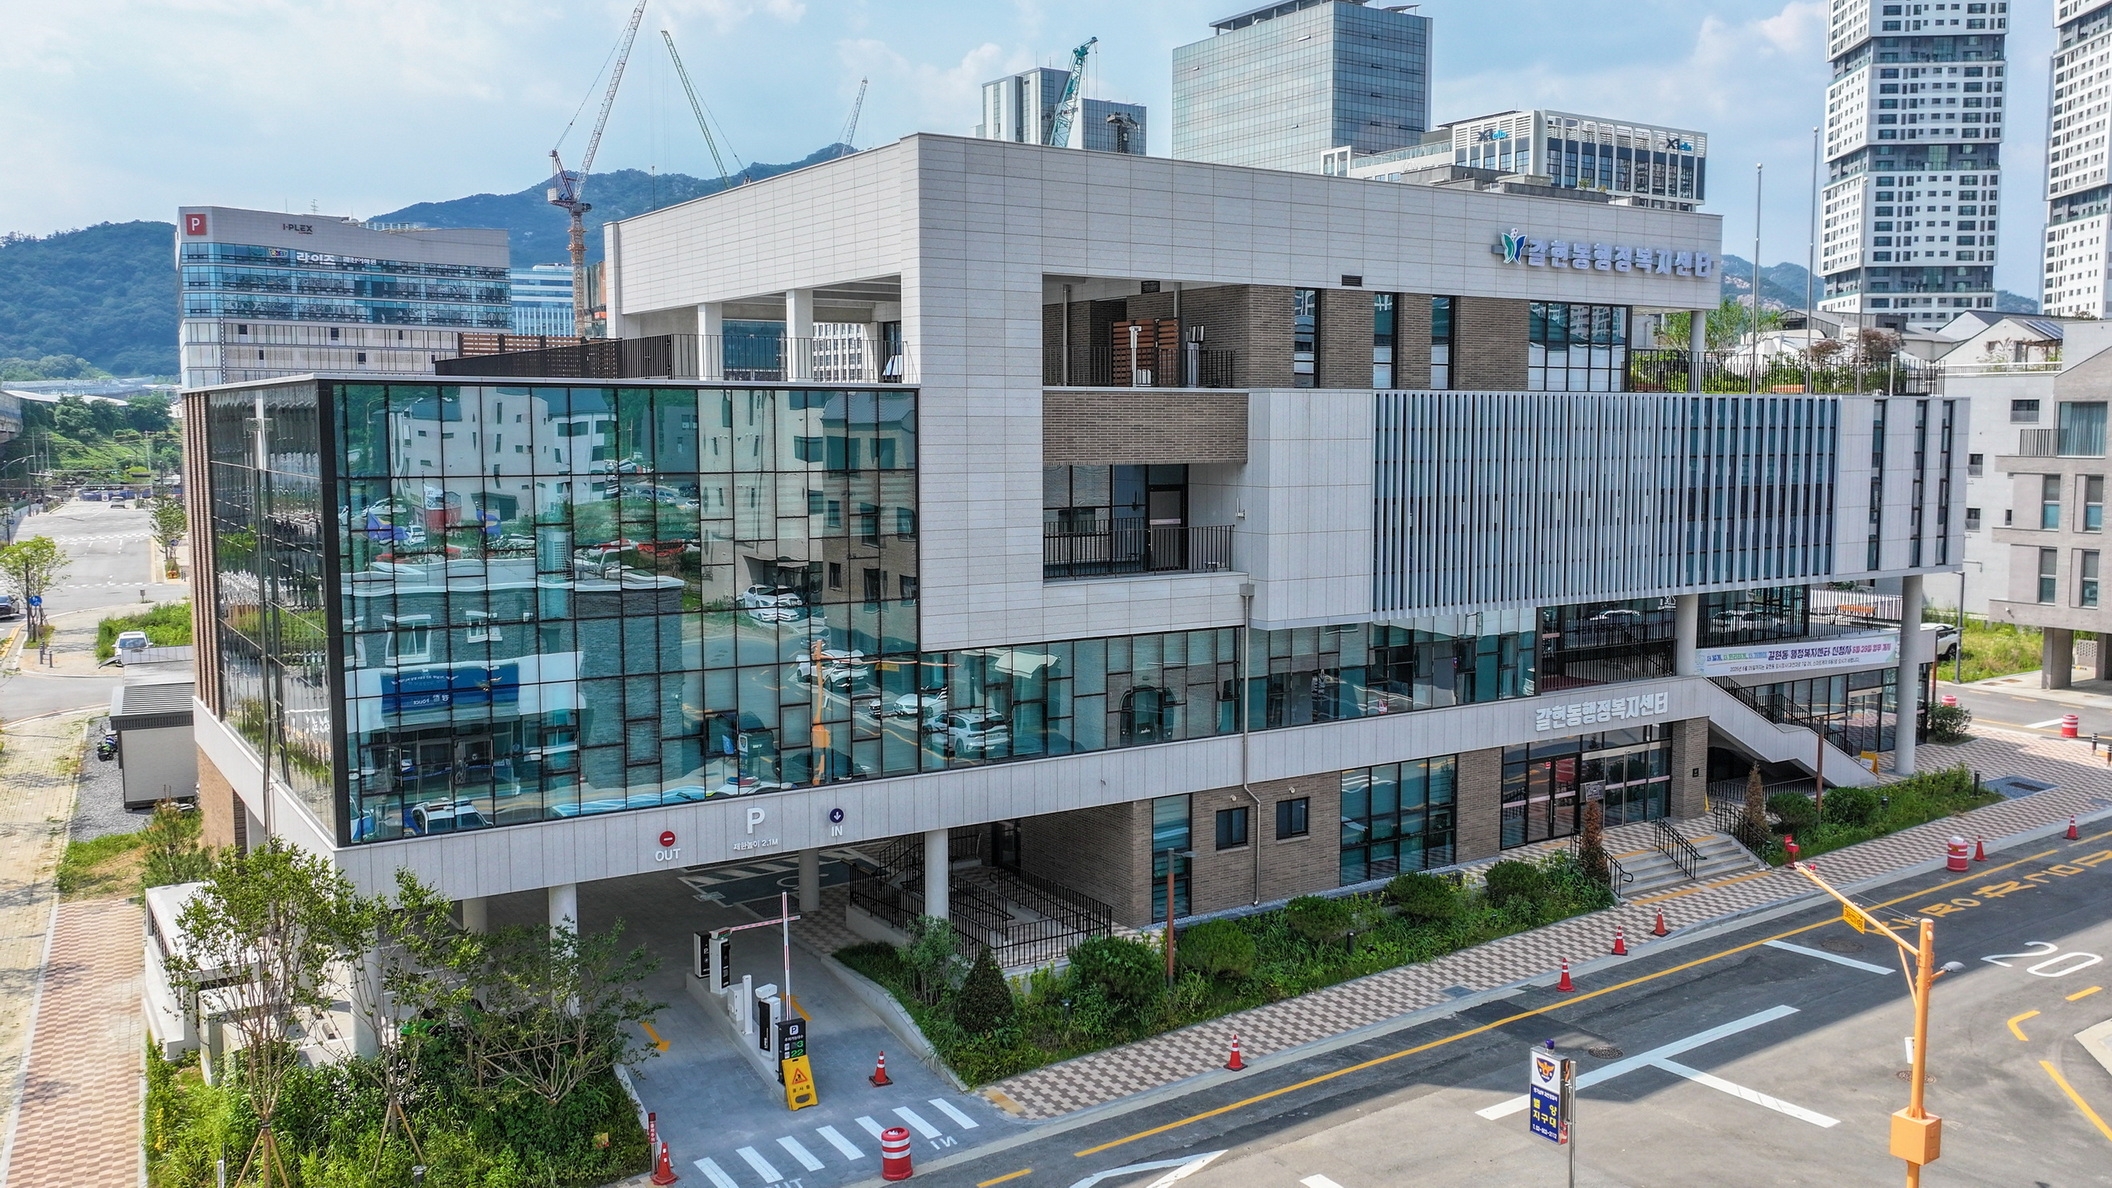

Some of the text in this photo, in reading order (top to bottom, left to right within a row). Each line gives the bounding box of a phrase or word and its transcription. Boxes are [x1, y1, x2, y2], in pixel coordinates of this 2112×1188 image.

[191, 217, 200, 231] P
[296, 251, 336, 266] 라이즈
[1528, 239, 1713, 278] 갈현동행정복지센터
[1768, 650, 1788, 661] 갈현동
[1790, 646, 1831, 659] 행정복지센터
[1535, 692, 1669, 732] 갈현동행정복지센터
[747, 807, 765, 834] P
[831, 825, 843, 837] IN
[761, 838, 779, 848] 2.1M
[655, 848, 681, 862] OUT
[1981, 941, 2103, 978] 20
[791, 1048, 804, 1058] 22
[1533, 1109, 1557, 1128] 지구대
